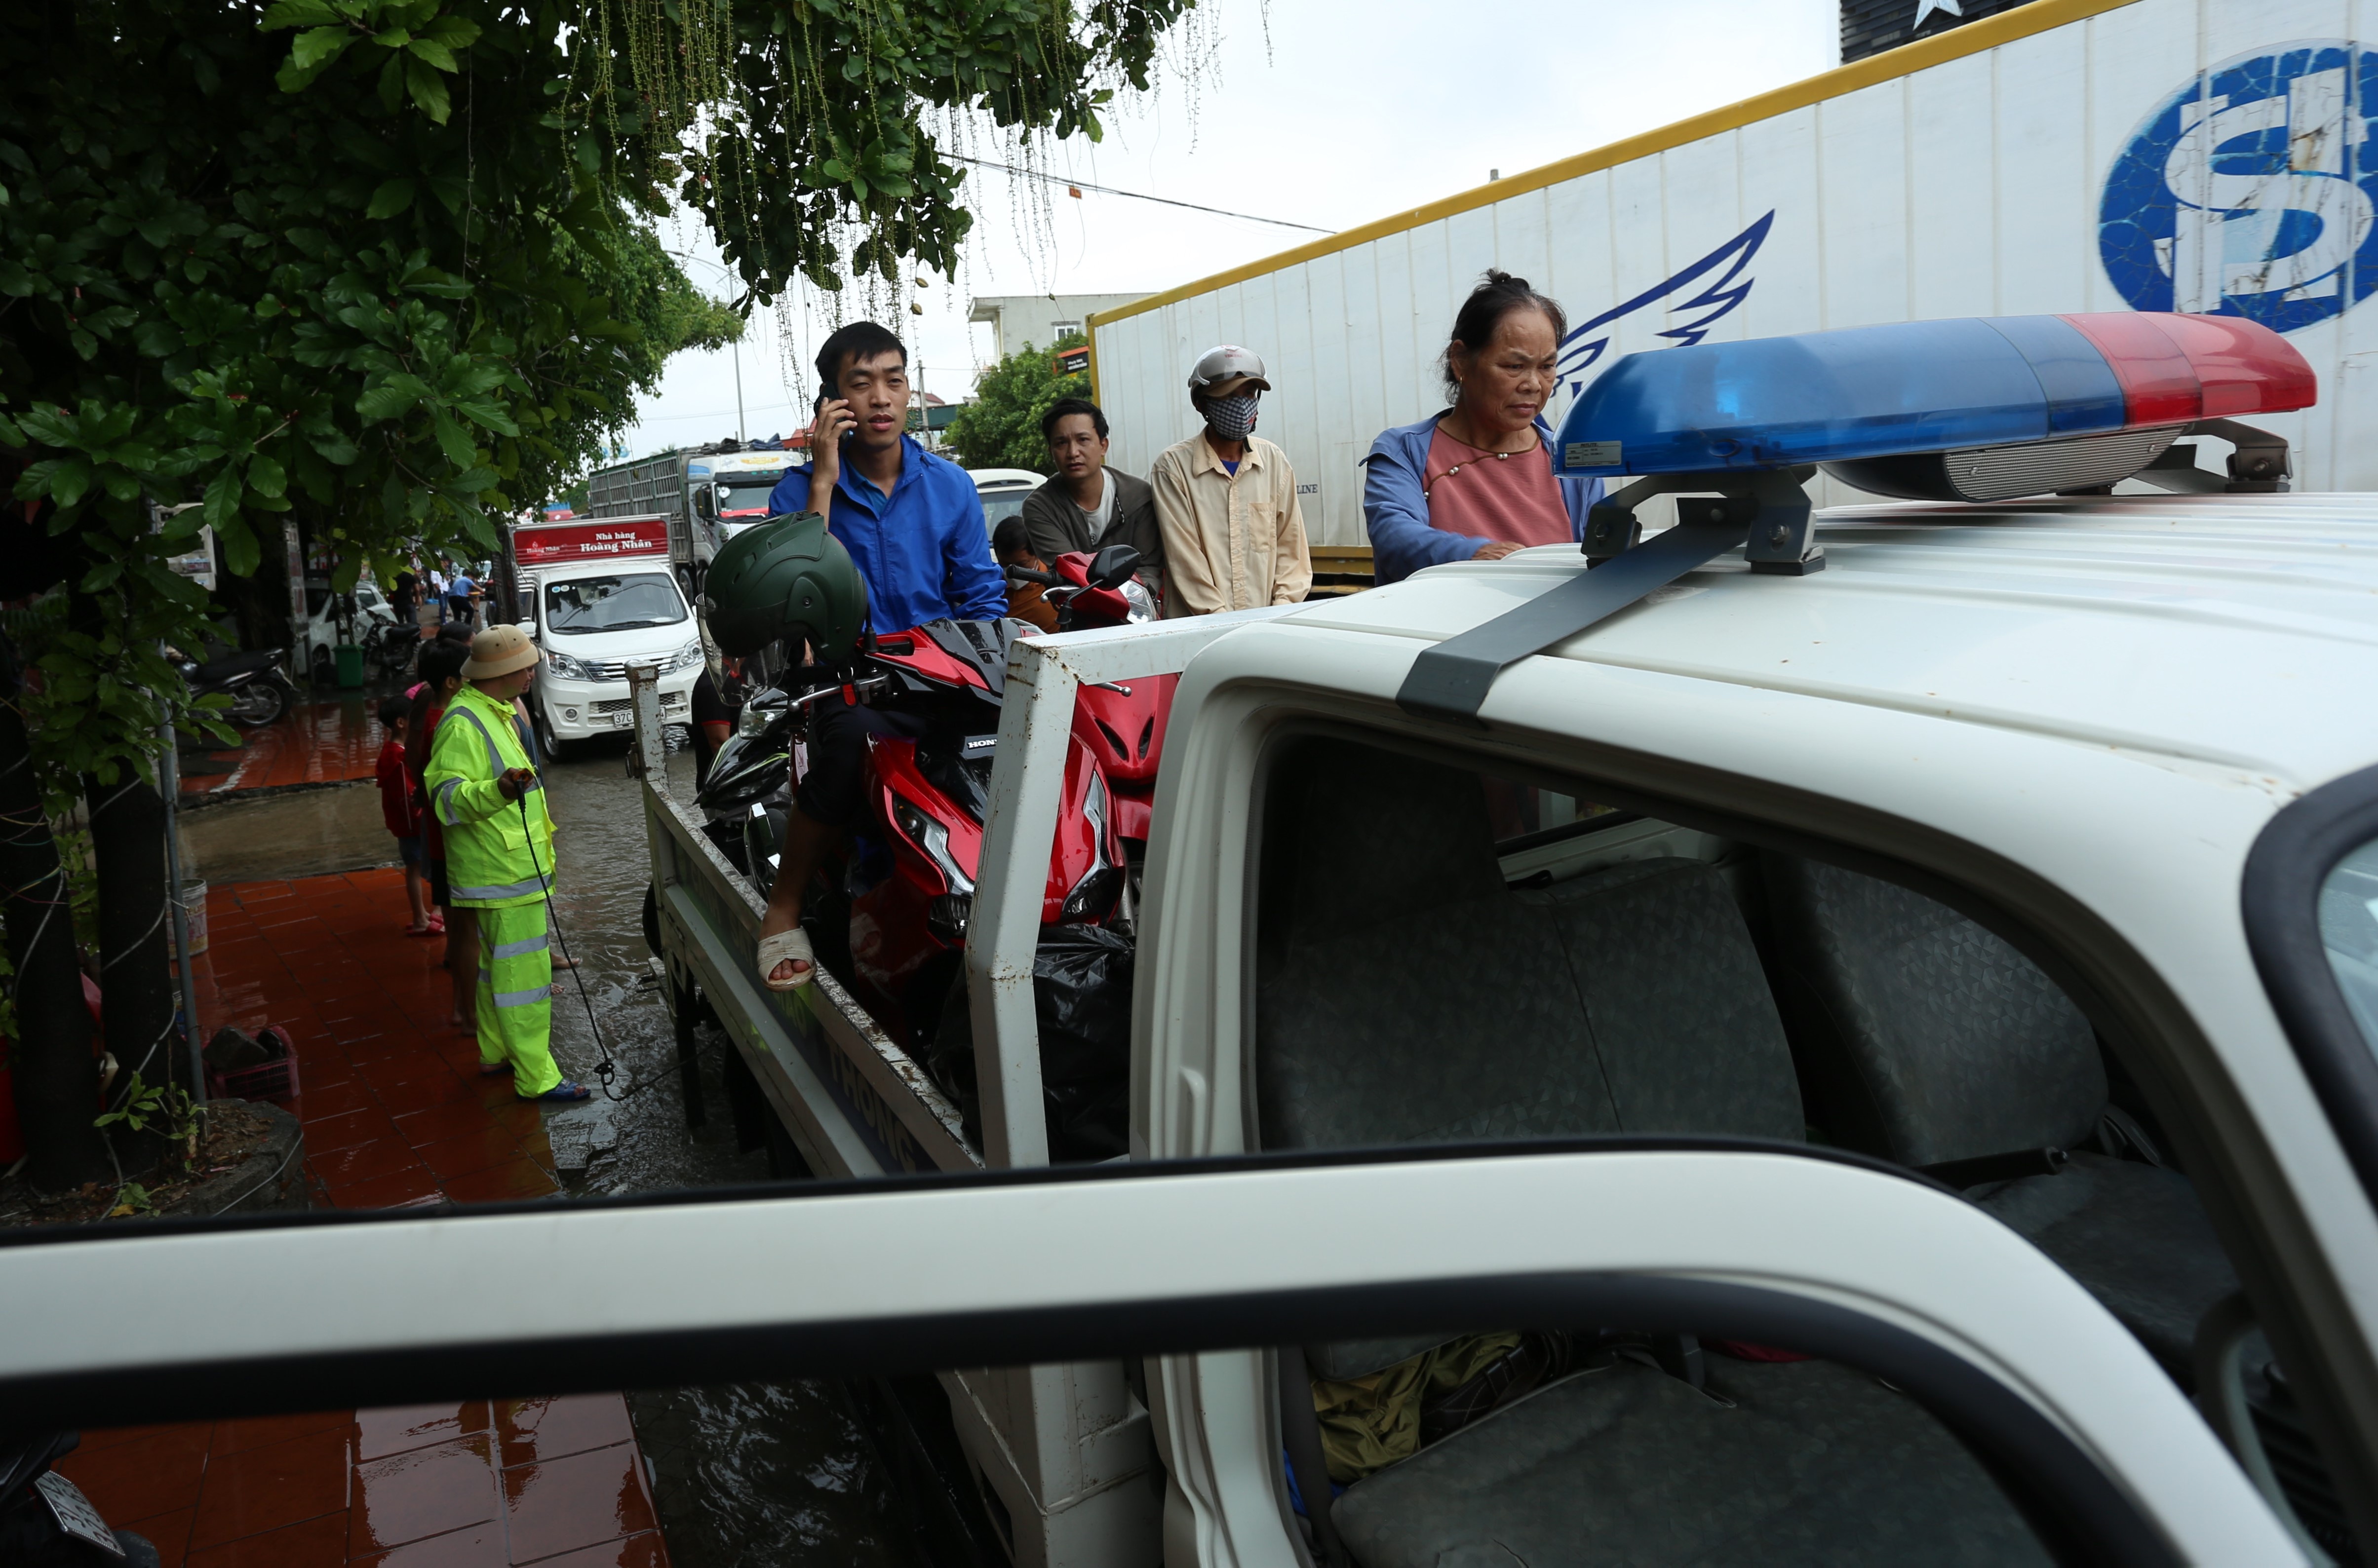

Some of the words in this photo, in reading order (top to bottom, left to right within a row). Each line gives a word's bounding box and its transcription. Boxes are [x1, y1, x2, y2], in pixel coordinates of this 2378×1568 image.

[1296, 484, 1318, 494] LINE
[596, 532, 613, 540] Nhà
[581, 541, 618, 552] Hoàng
[622, 539, 652, 549] Nhân
